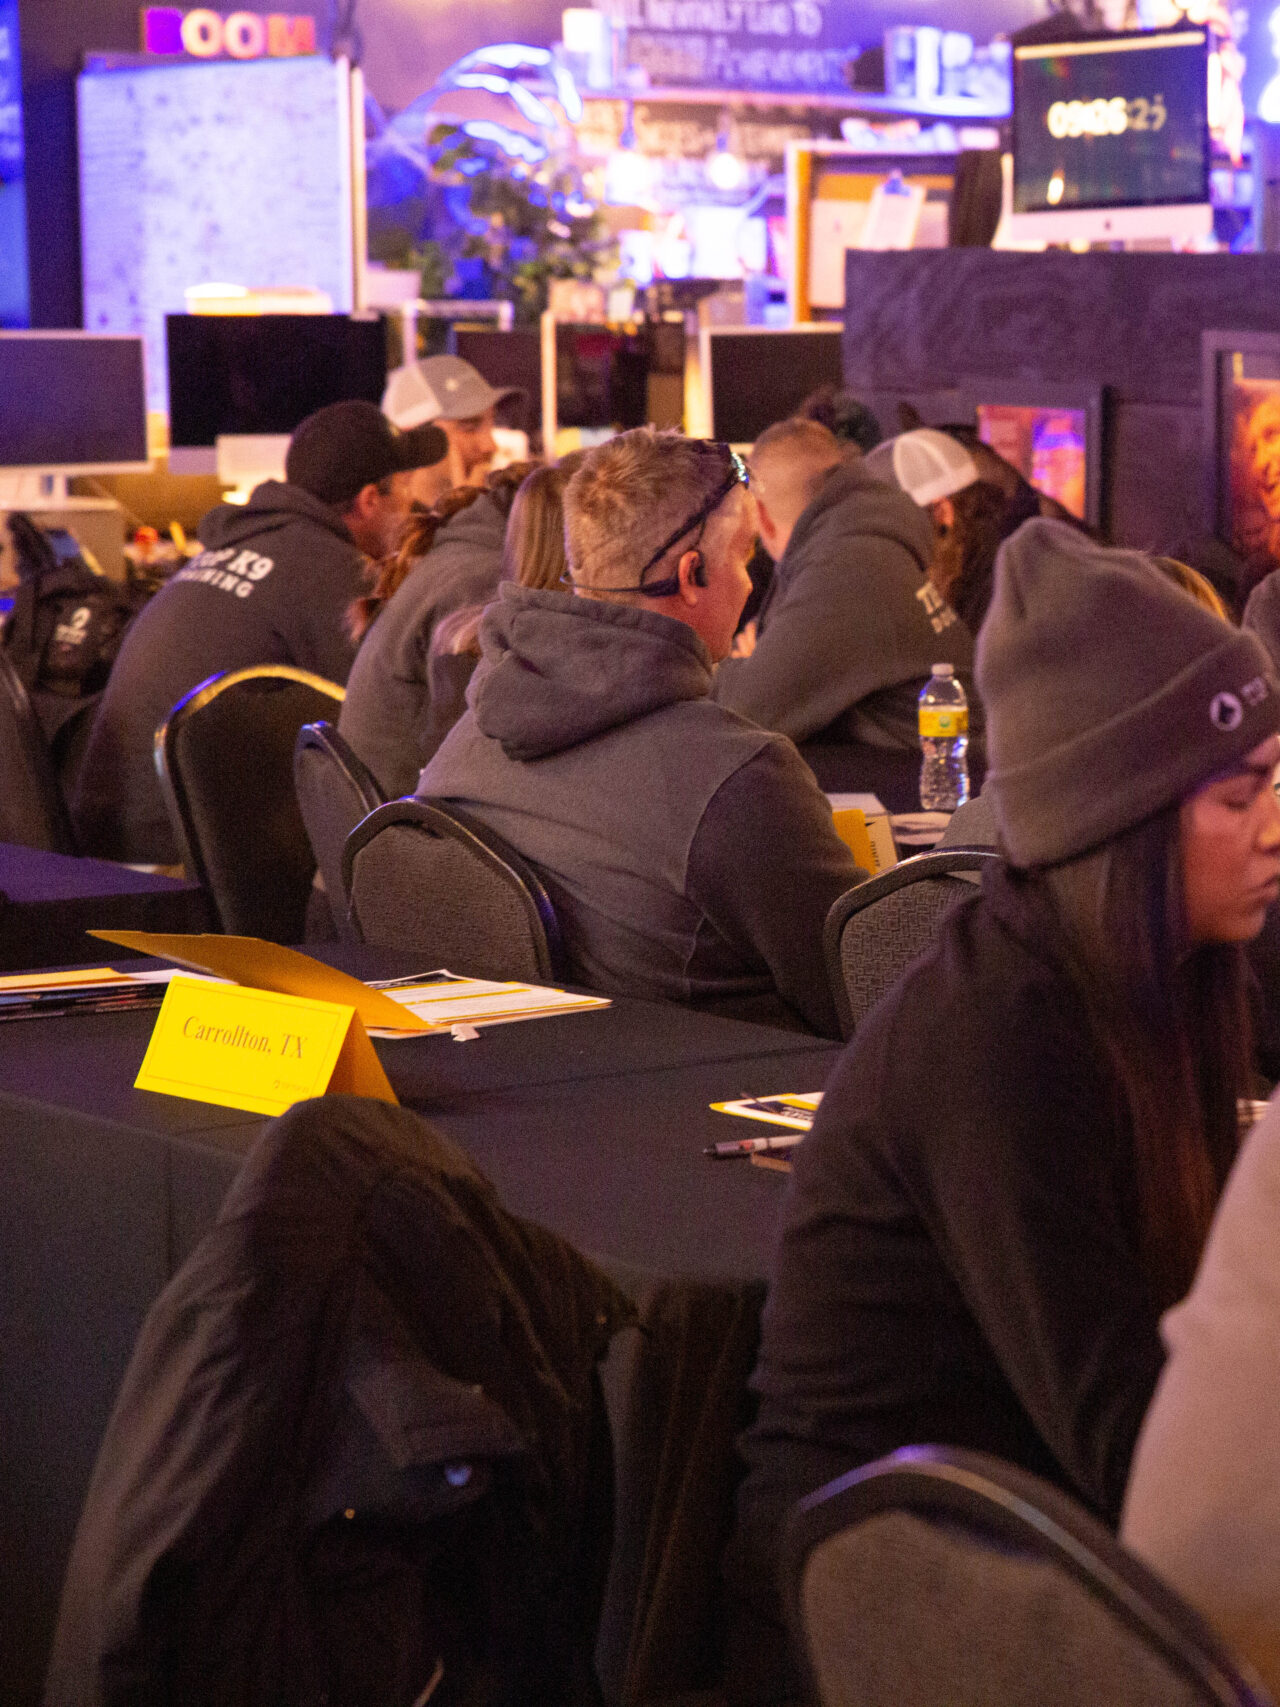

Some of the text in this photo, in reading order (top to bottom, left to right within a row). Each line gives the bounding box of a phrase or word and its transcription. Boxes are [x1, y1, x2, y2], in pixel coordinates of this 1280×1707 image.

[227, 550, 274, 580] K9
[183, 1015, 308, 1059] Carrollton, TX
